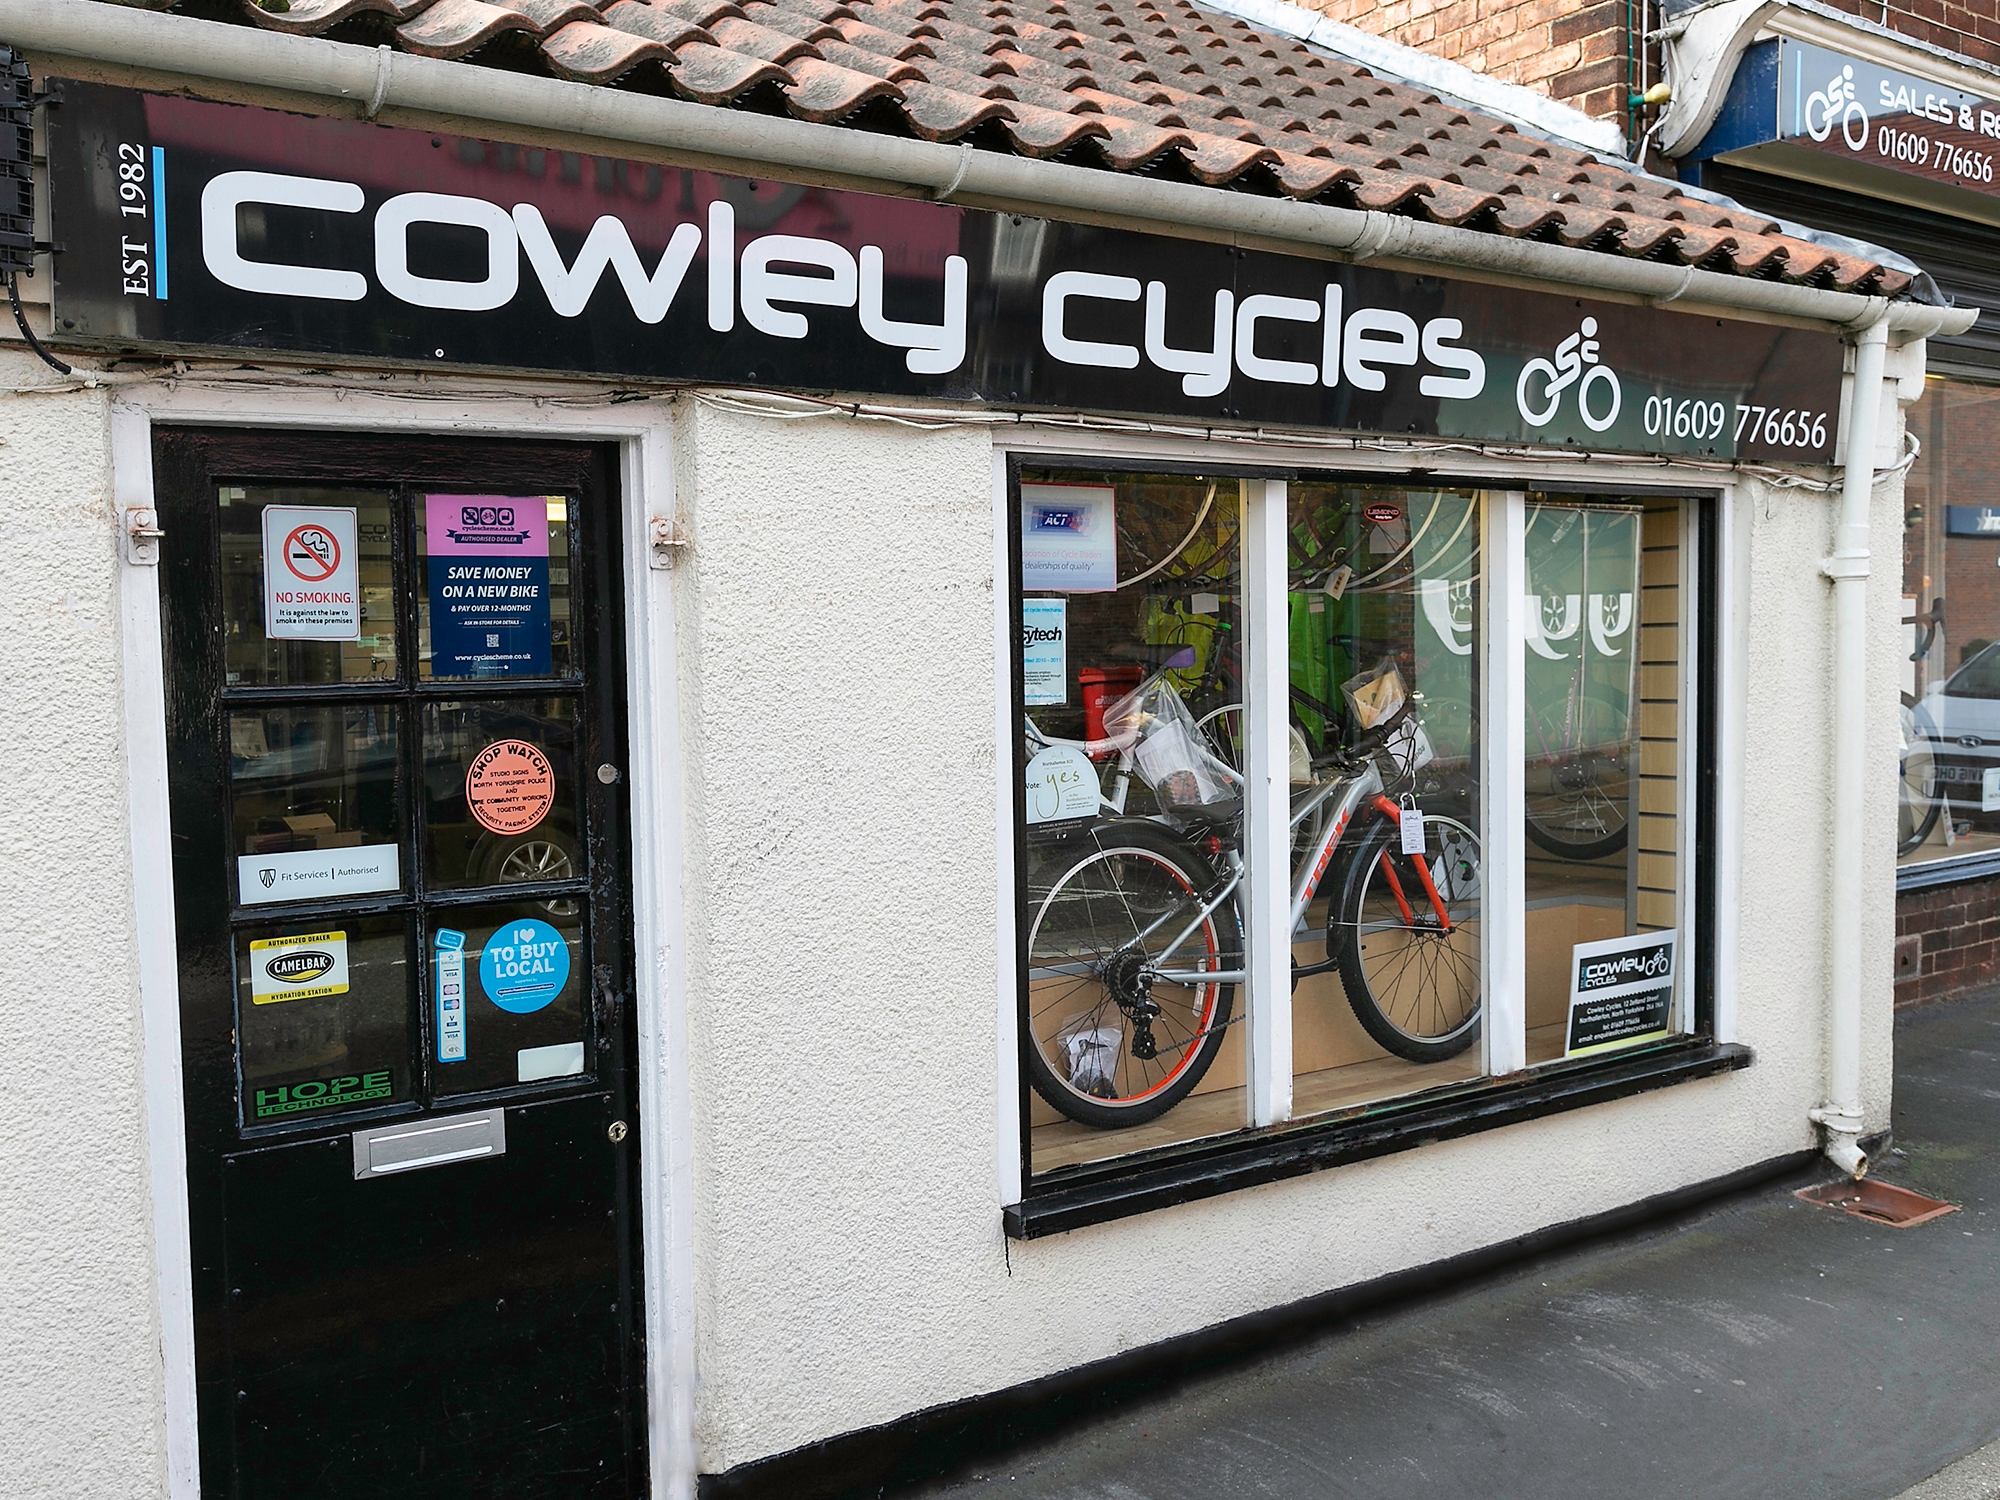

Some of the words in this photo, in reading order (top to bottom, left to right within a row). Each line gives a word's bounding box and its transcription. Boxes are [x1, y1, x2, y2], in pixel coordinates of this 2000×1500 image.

[1879, 79, 1953, 125] SALES
[1958, 103, 1975, 132] &
[1878, 125, 1929, 165] 01609
[1933, 140, 1993, 183] 776656
[118, 142, 147, 218] 1982
[121, 235, 149, 297] EST
[1643, 394, 1726, 442] 01609
[1733, 404, 1828, 450] 776656
[1044, 513, 1068, 526] ACT
[1061, 550, 1078, 559] Cycle
[1079, 550, 1102, 559] Traders
[447, 567, 481, 579] SAVE
[483, 567, 532, 579] MONEY
[1061, 562, 1069, 570] of
[276, 592, 293, 604] NO
[296, 592, 354, 604] SMOKING.
[442, 585, 462, 598] ON
[465, 585, 475, 598] A
[477, 585, 508, 598] NEW
[509, 585, 539, 598] BIKE
[293, 609, 317, 618] against
[450, 605, 457, 613] &
[490, 604, 532, 612] 12-MONTHS!
[324, 618, 353, 626] premises
[454, 653, 532, 661] www.cyclescheme.co.uk
[473, 748, 501, 780] SHOP
[507, 744, 547, 776] WATCH
[495, 779, 526, 787] YORKSHIRE
[1036, 770, 1080, 819] yes
[477, 805, 503, 826] SECURITY
[496, 805, 527, 813] TOGETHER
[1300, 806, 1352, 902] TREK
[281, 872, 292, 881] Fit
[294, 870, 329, 880] Services
[337, 865, 379, 876] Authorised
[267, 937, 306, 947] AUTHORIZED
[308, 934, 331, 942] DEALER
[513, 930, 519, 945] I
[490, 946, 515, 963] TO
[520, 941, 559, 960] BUY
[274, 956, 327, 974] CAMELBAK
[495, 958, 555, 979] LOCAL
[270, 991, 306, 1001] HYDRATION
[307, 987, 333, 996] STATION
[1586, 1005, 1605, 1015] Cowley
[1611, 1010, 1625, 1019] North
[1625, 1006, 1644, 1016] Yorkshire
[256, 1070, 391, 1106] HOPE
[258, 1087, 391, 1115] TECHNOLOGY
